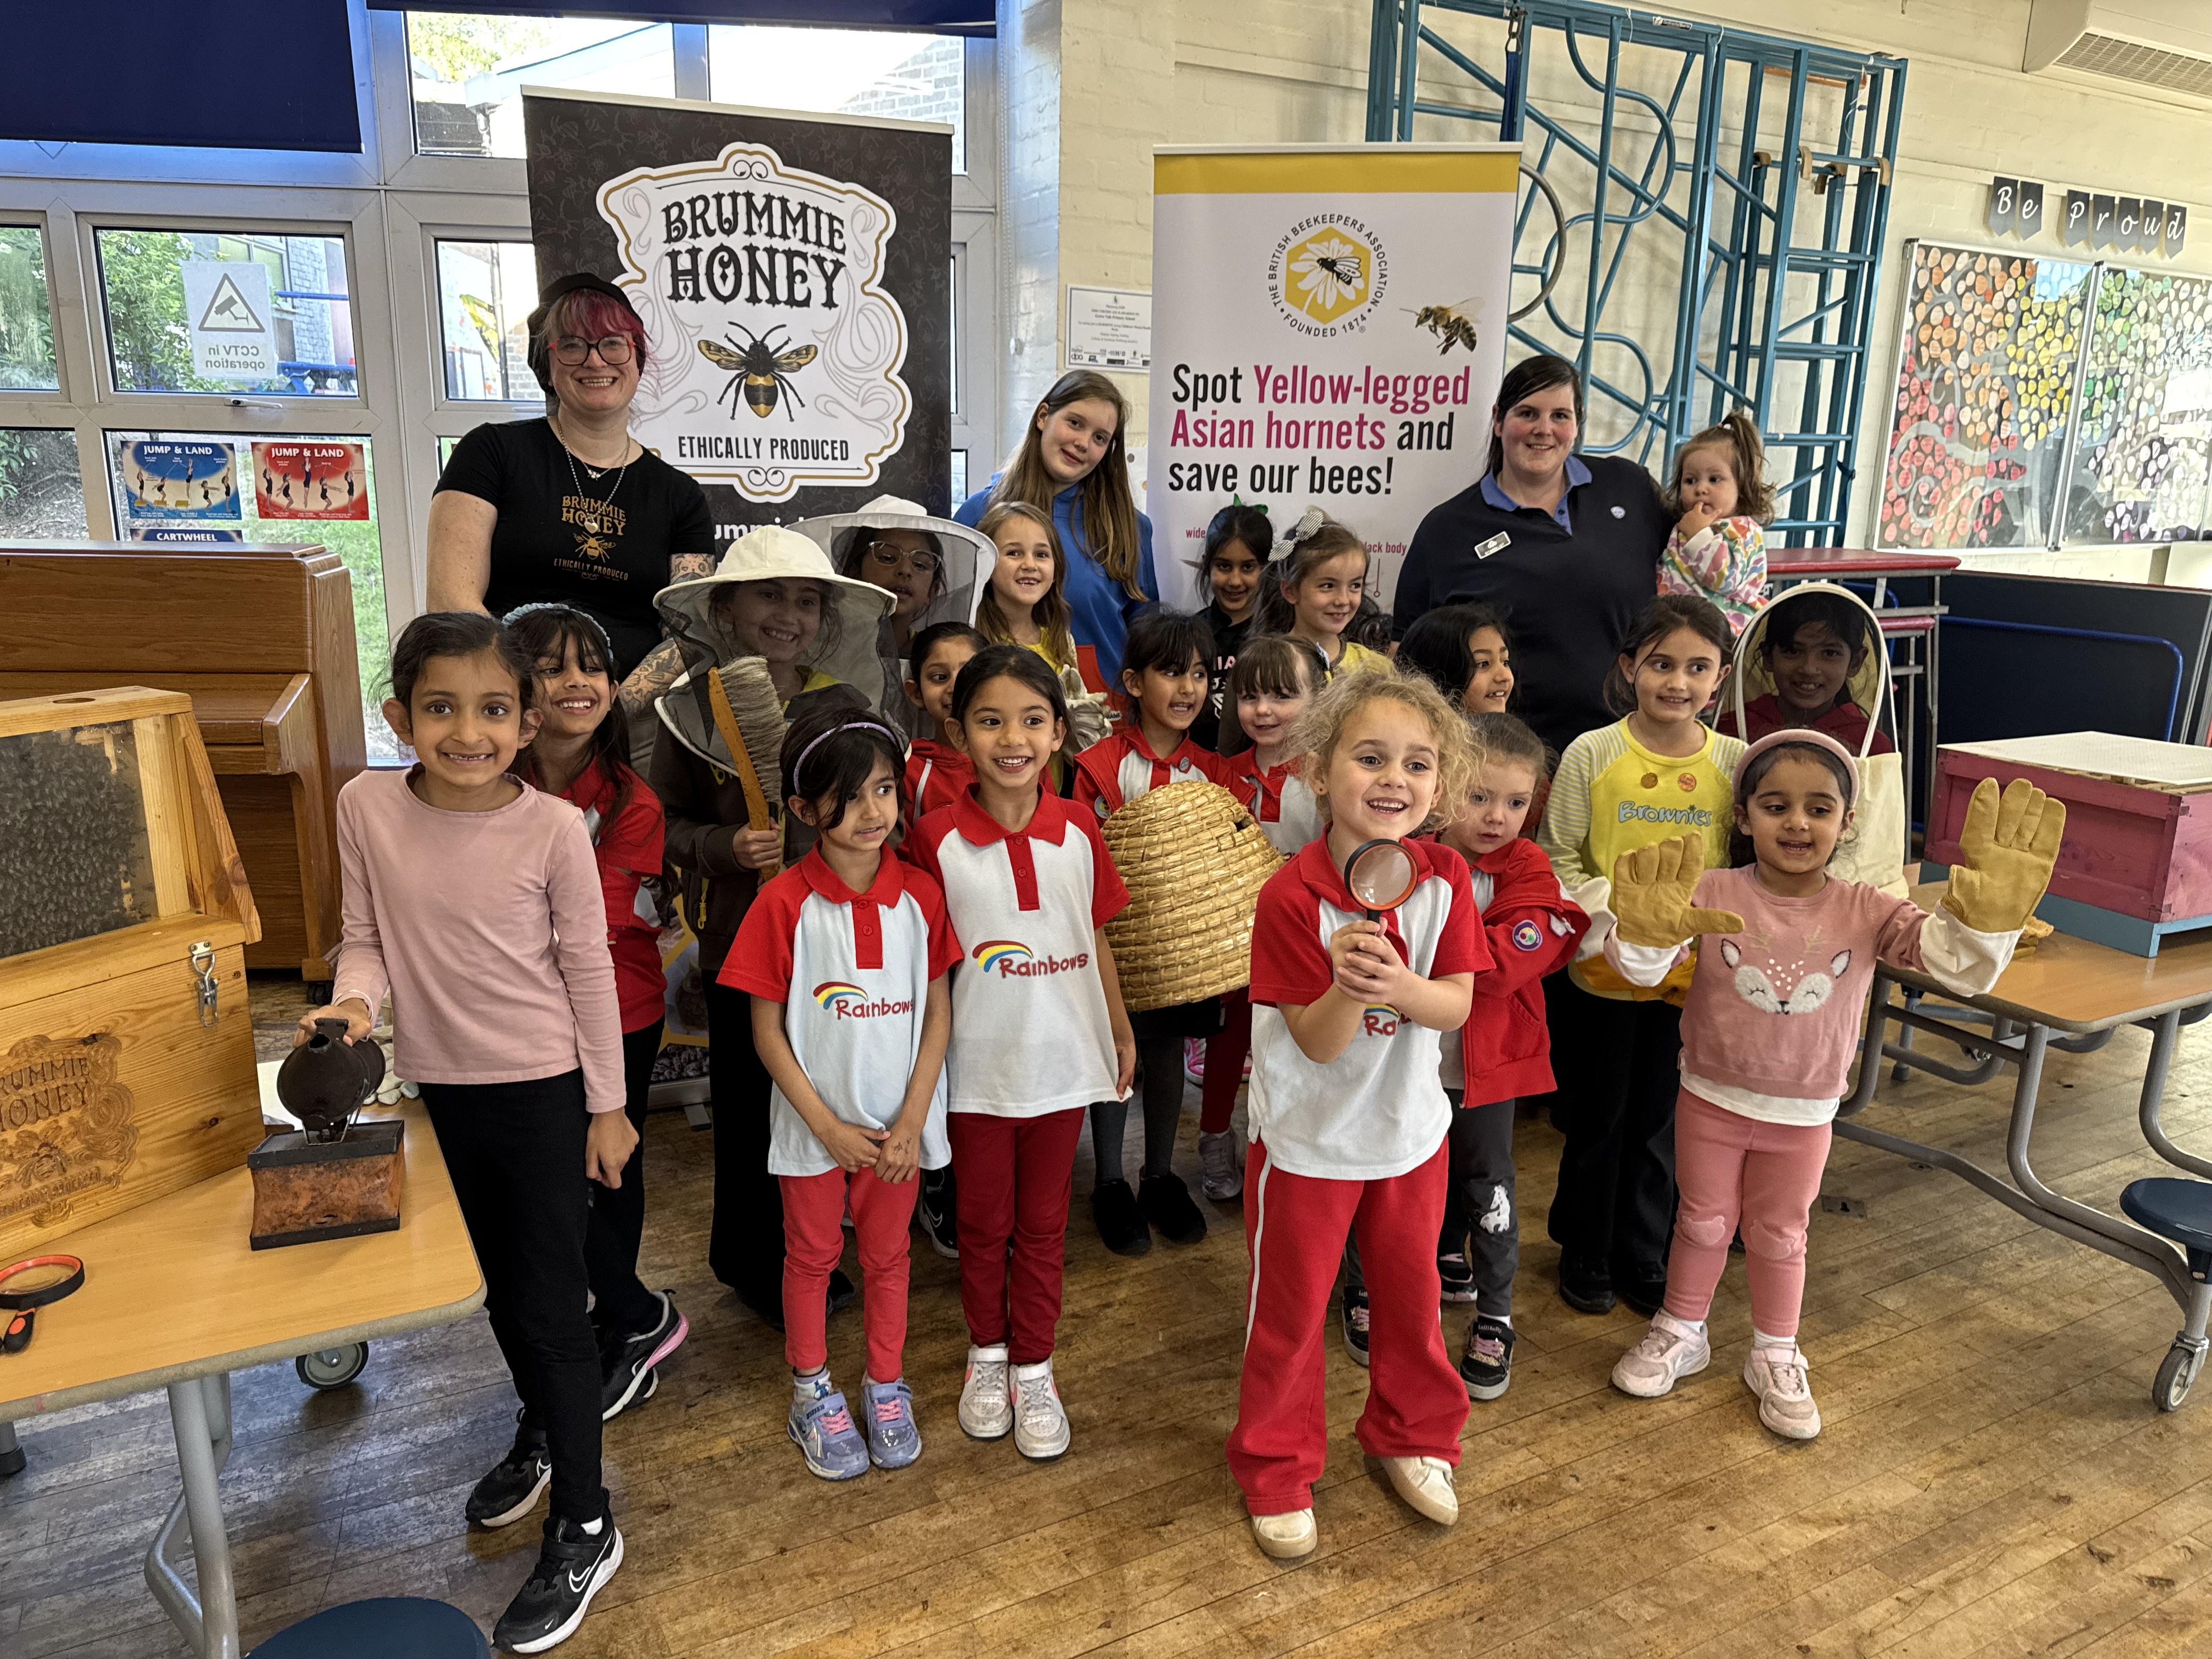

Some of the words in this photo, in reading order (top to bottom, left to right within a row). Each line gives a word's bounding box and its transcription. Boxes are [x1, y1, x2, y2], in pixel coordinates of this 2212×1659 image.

[661, 190, 846, 256] BRUMMIE
[1291, 213, 1365, 237] BEEKEEPERS
[1997, 186, 2039, 219] Be
[2069, 201, 2183, 240] Proud
[1268, 234, 1291, 280] BRITISH
[1364, 231, 1388, 307] ASSOCIATION
[665, 242, 847, 310] HONEY
[1268, 284, 1282, 307] THE
[1283, 313, 1336, 337] FOUNDED
[1342, 314, 1367, 333] 1874
[1172, 363, 1242, 412] Spot
[1254, 365, 1470, 414] Yellow-legged
[1170, 409, 1254, 448] Asian
[1266, 411, 1385, 450] hornets
[1397, 412, 1454, 450] and
[144, 445, 171, 455] JUMP
[174, 446, 183, 454] &
[185, 446, 212, 455] LAND
[272, 448, 300, 458] JUMP
[303, 448, 311, 457] &
[314, 448, 344, 458] LAND
[678, 436, 762, 459] ETHICALLY
[770, 438, 849, 461] PRODUCED
[1168, 462, 1238, 492] save
[1250, 464, 1299, 493] our
[1309, 456, 1393, 494] bees!
[562, 495, 627, 522] BRUMMIE
[156, 533, 217, 541] CARTWHEEL
[1186, 527, 1205, 538] wide
[1364, 541, 1383, 554] lack
[1385, 542, 1407, 556] body
[554, 558, 590, 571] ETHICALLY
[593, 565, 628, 580] PRODUCED
[1618, 800, 1712, 827] Brownies
[999, 953, 1089, 979] Rainbows
[836, 997, 913, 1020] Rainbows
[0, 1057, 90, 1096] RUMMIE
